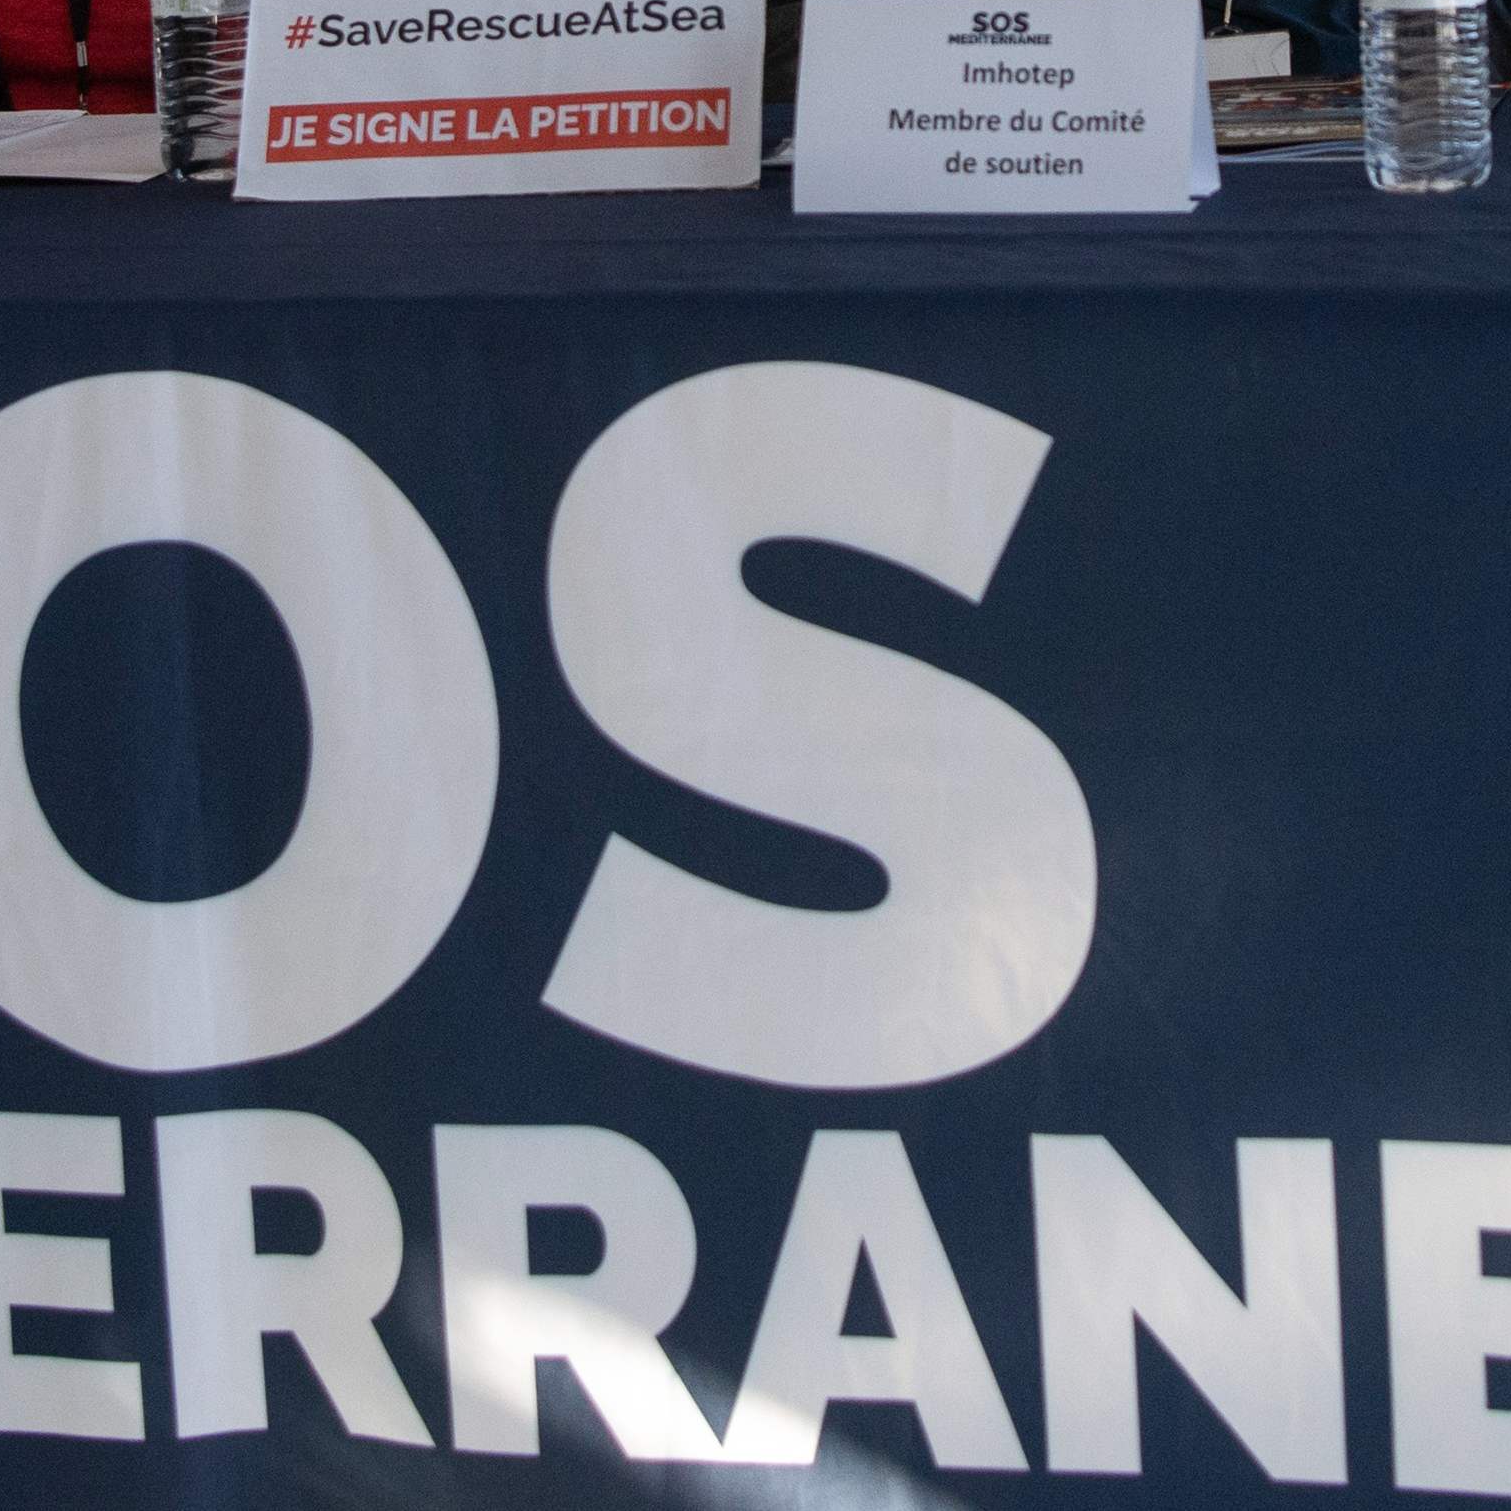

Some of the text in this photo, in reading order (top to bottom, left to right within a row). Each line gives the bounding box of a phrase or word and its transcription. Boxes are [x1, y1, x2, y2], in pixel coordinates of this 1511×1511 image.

[284, 0, 725, 50] #SaveRescueAtSea
[972, 12, 1030, 33] SOS
[963, 62, 1075, 89] Imhotep
[269, 99, 727, 149] JE SIGNE LA PETITION
[889, 108, 1145, 133] Membre du Comité
[945, 151, 1084, 175] de soutien
